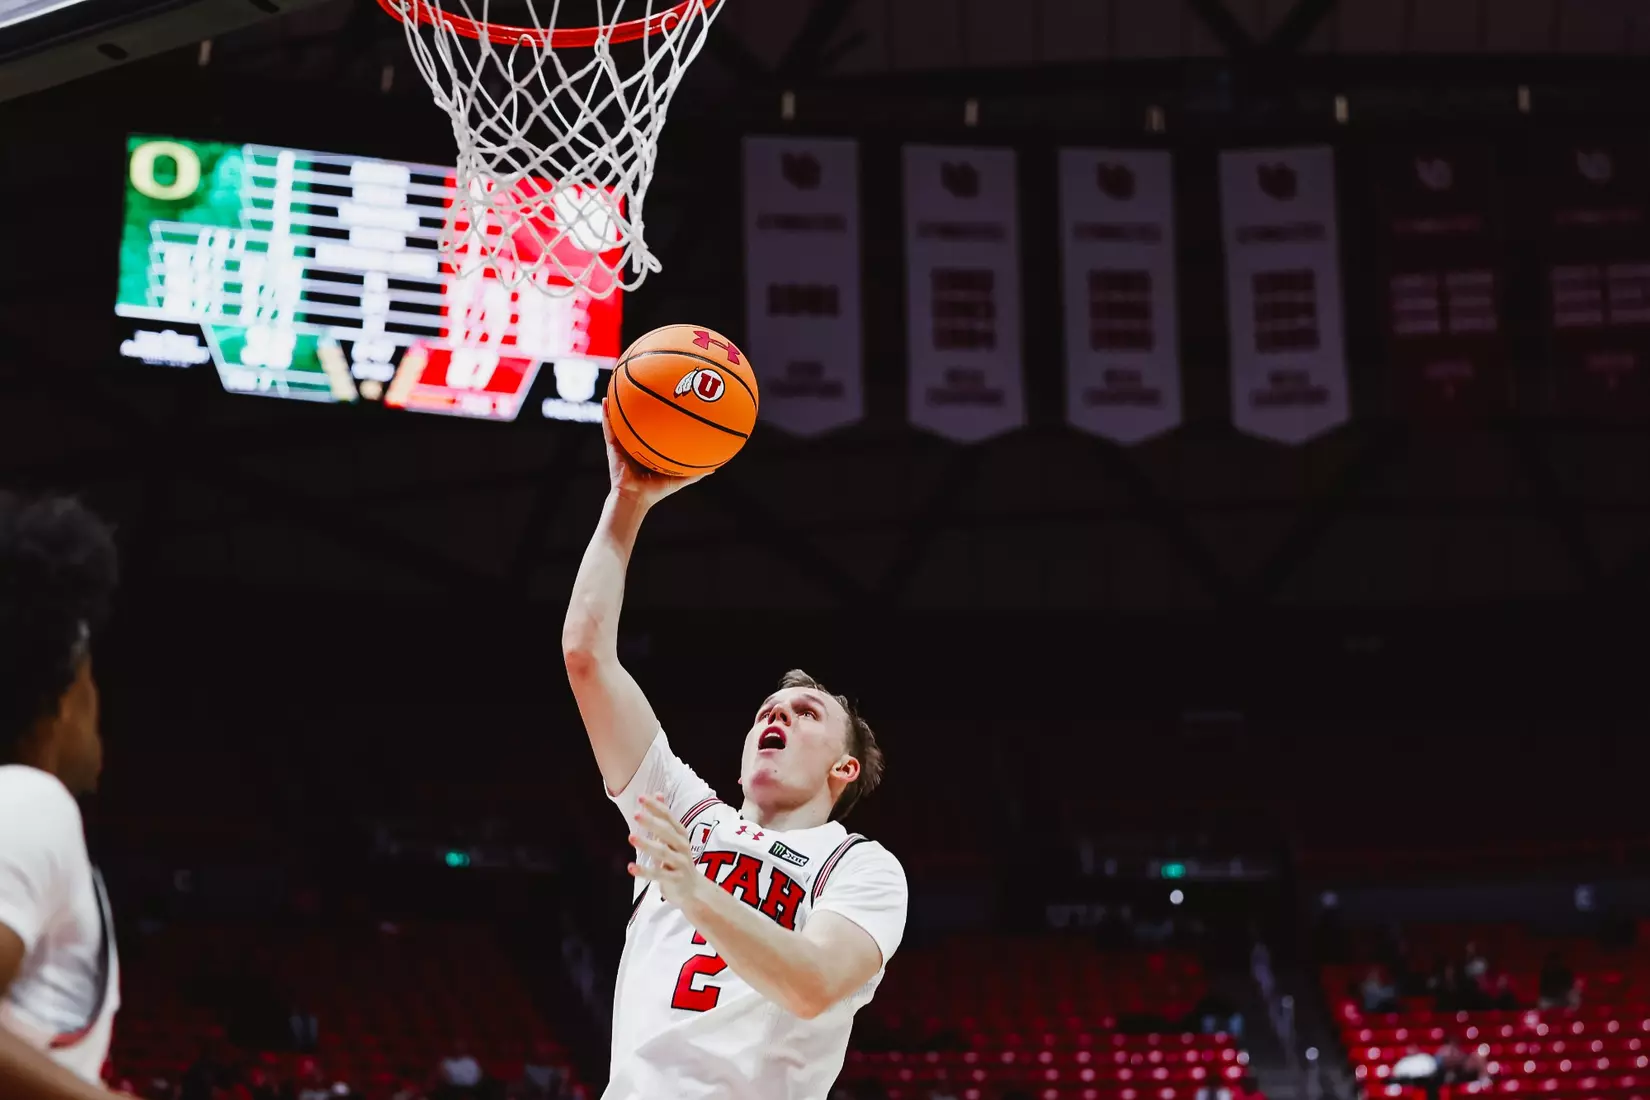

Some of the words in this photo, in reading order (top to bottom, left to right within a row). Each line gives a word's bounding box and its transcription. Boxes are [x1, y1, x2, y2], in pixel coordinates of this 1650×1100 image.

[129, 141, 201, 200] O
[698, 372, 722, 399] U
[693, 851, 807, 931] TAH
[671, 929, 728, 1012] 2
